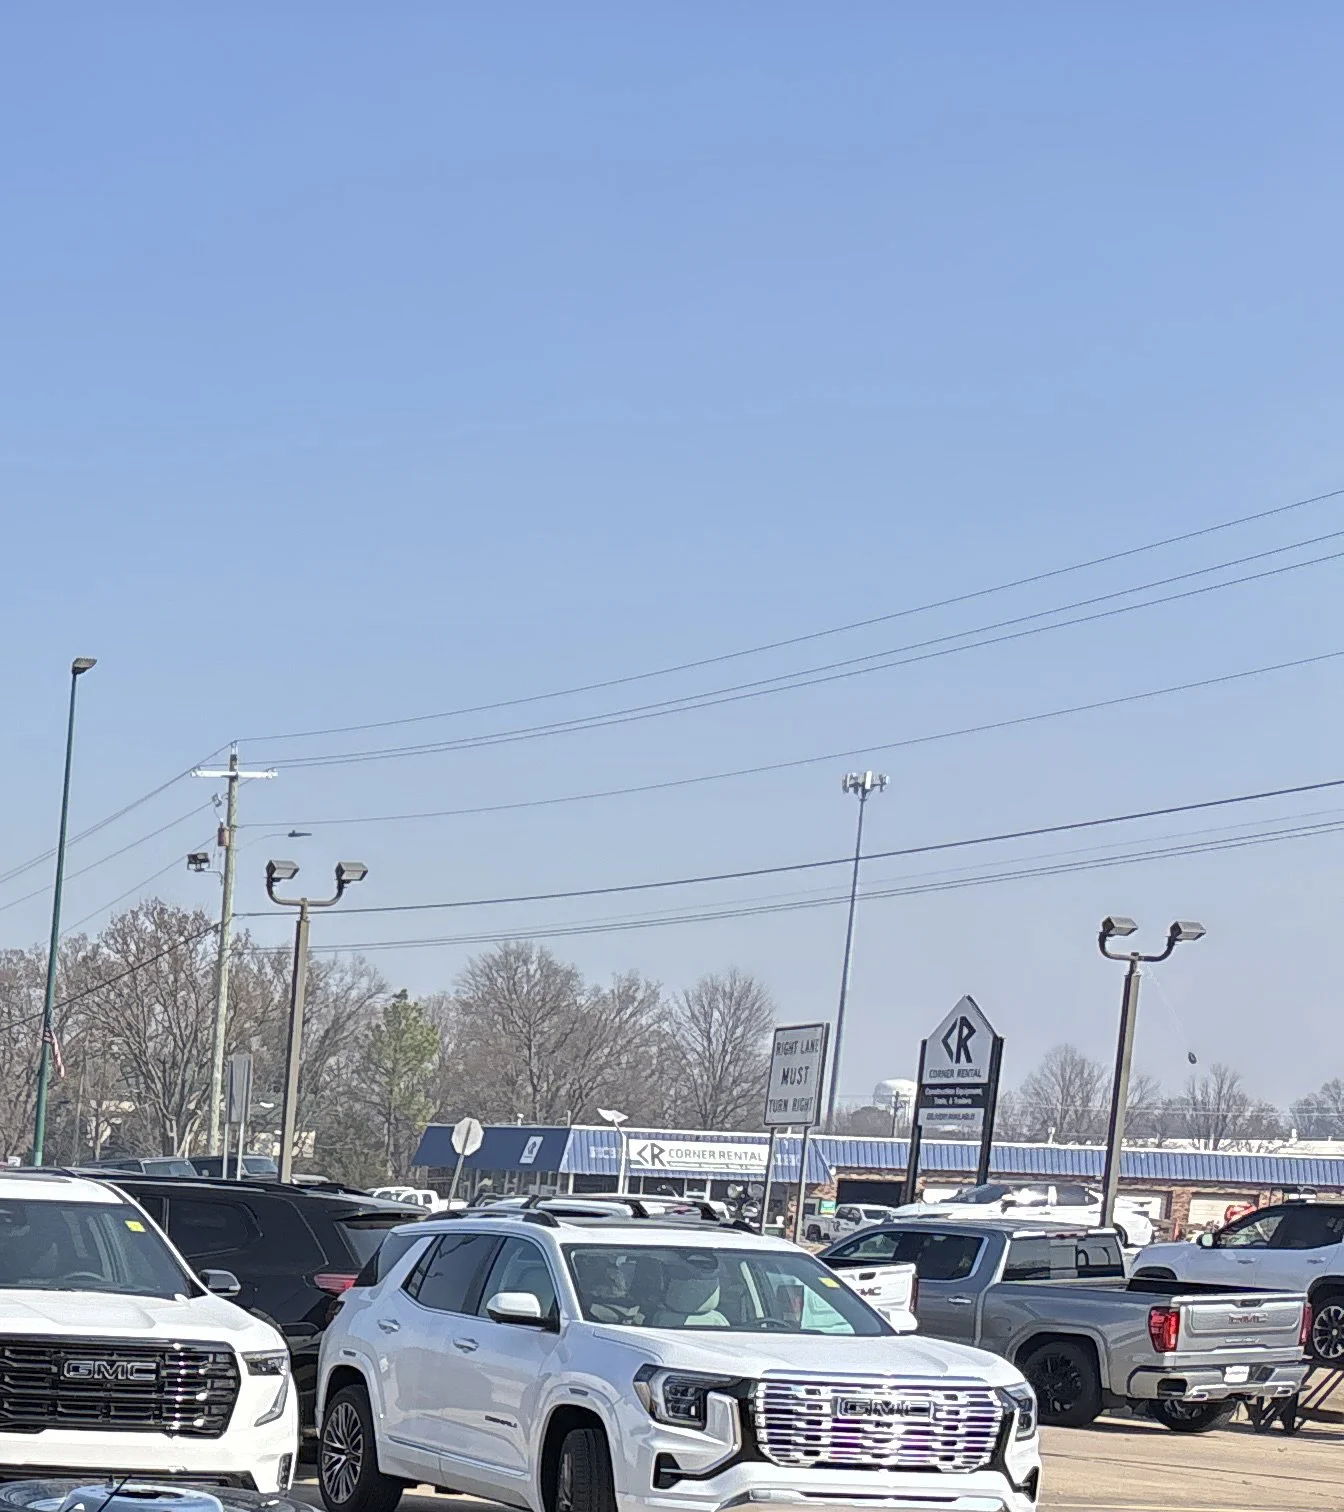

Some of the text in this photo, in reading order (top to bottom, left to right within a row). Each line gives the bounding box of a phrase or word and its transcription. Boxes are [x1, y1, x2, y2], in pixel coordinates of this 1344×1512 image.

[775, 1038, 820, 1057] RIGHT LANE
[781, 1065, 810, 1086] MUST
[928, 1067, 983, 1079] CORNER RENTAL
[768, 1096, 814, 1113] TURN RIGHT
[668, 1147, 716, 1161] CORNER
[718, 1149, 764, 1163] RENTAL
[63, 1360, 157, 1381] GMC
